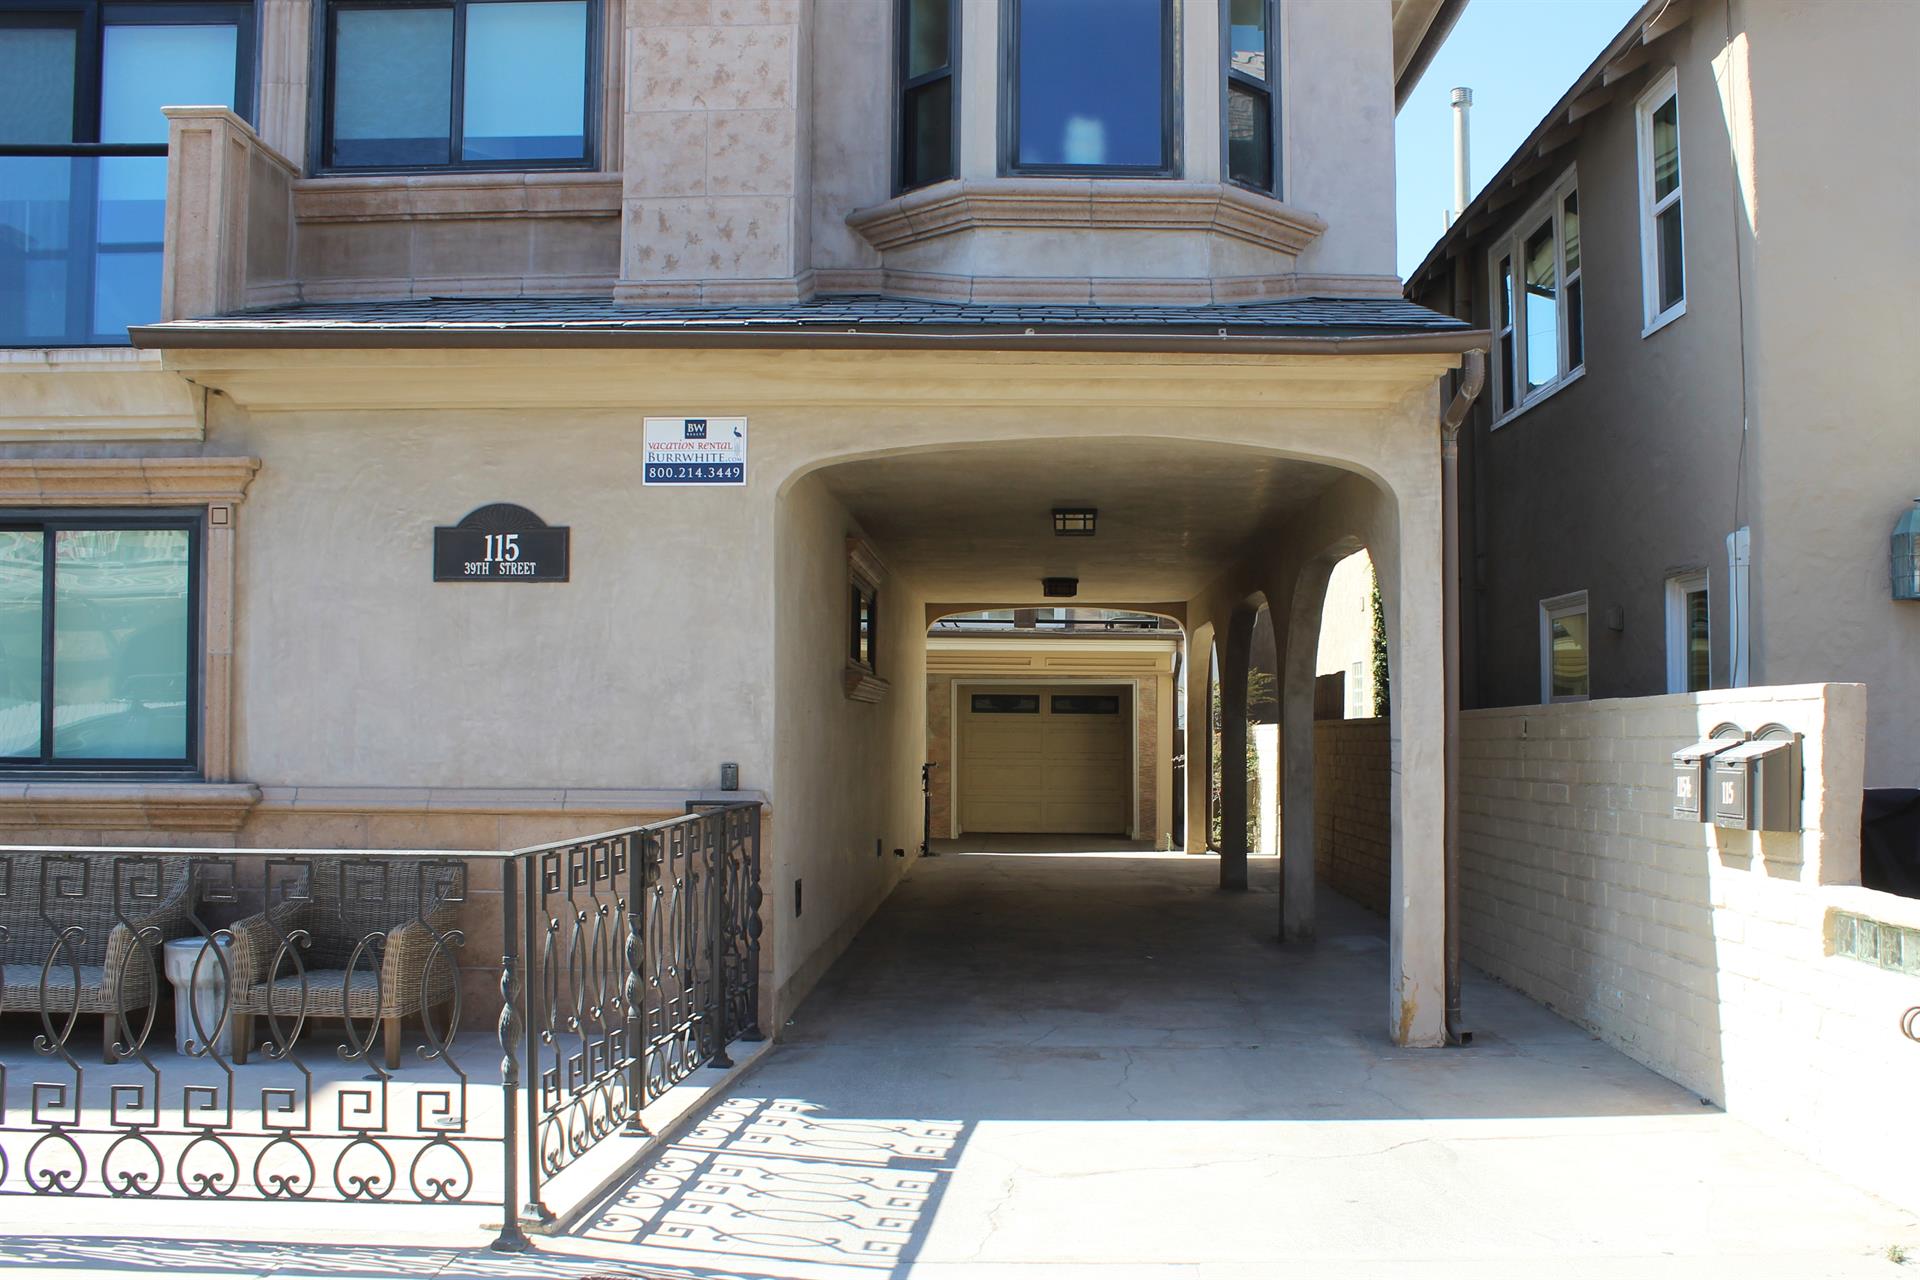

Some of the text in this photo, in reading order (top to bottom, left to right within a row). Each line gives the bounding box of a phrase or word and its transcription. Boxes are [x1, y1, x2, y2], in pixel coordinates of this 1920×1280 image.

[688, 423, 705, 433] BW
[649, 467, 740, 478] 800.214.3449
[484, 534, 520, 562] 115
[464, 562, 536, 575] 39TH STREET
[1721, 781, 1735, 804] 115
